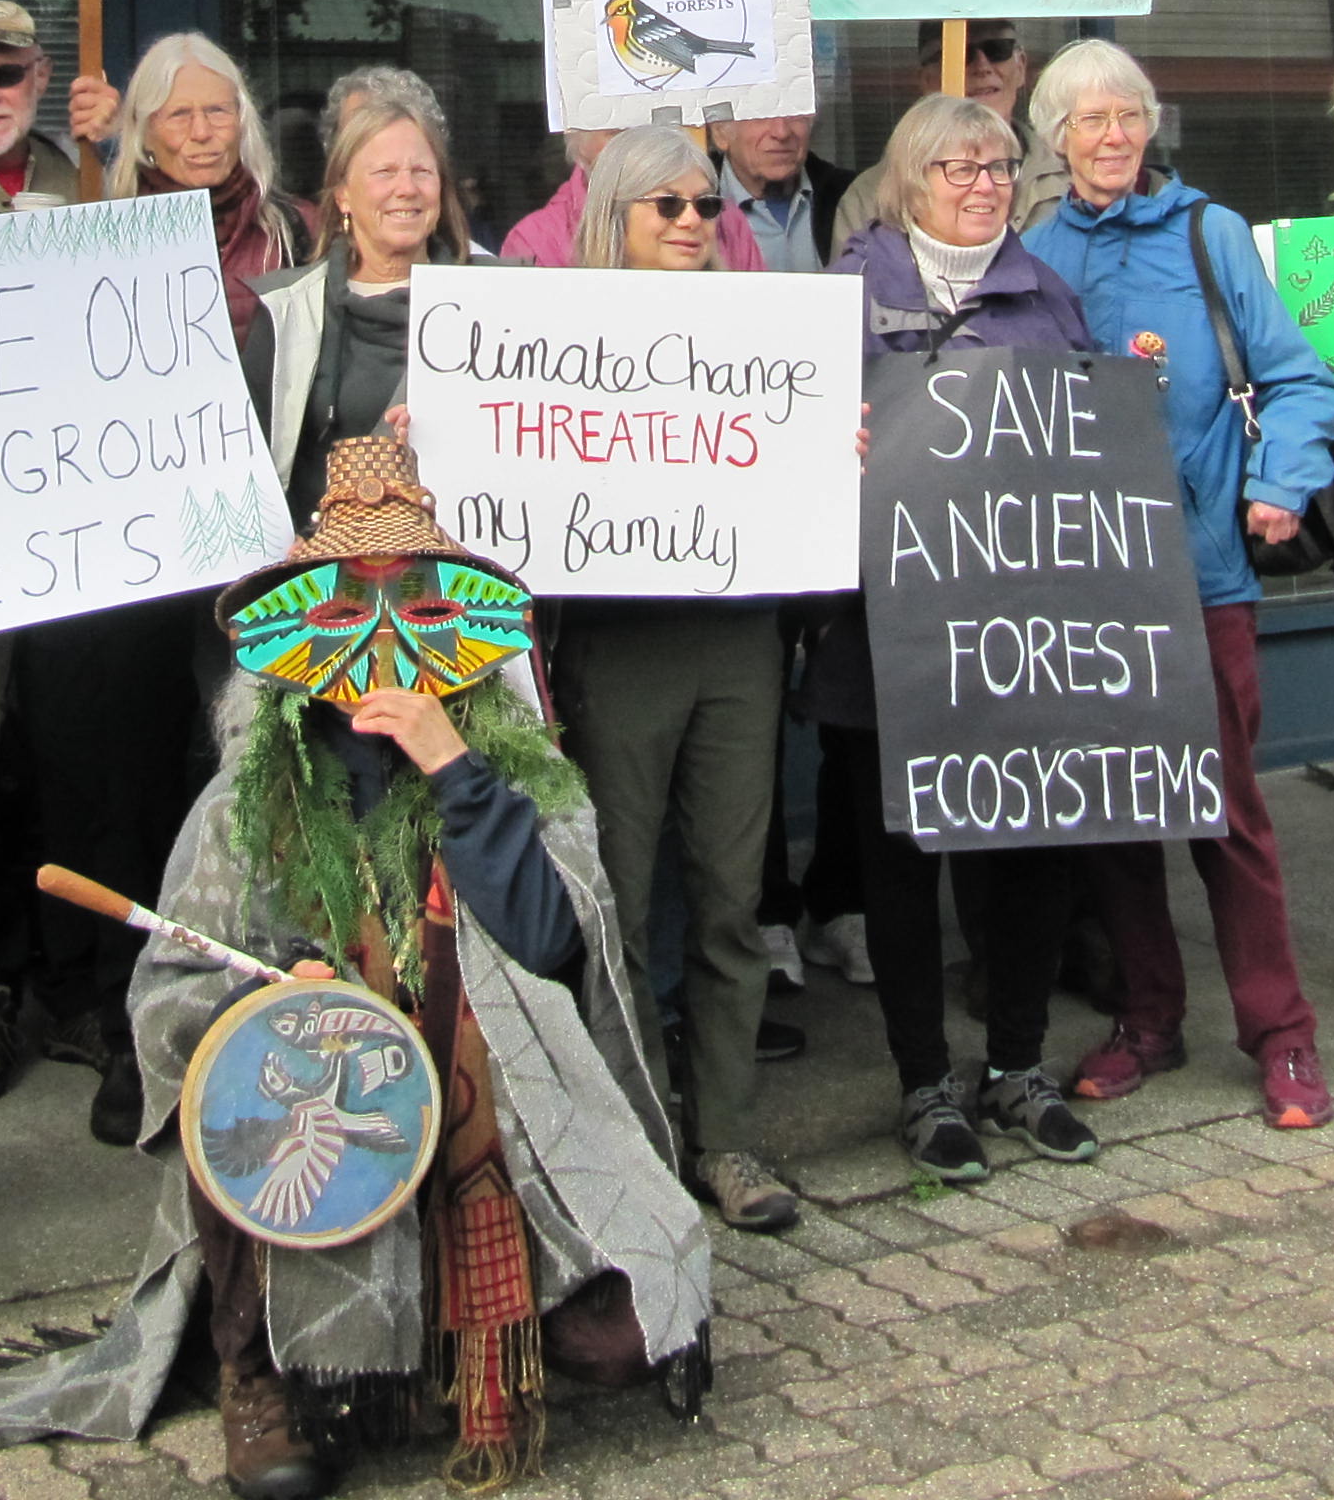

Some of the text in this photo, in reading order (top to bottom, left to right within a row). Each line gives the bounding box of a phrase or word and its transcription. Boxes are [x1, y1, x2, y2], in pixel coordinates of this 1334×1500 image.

[86, 264, 234, 381] OUR
[417, 301, 825, 425] Climate Change
[0, 399, 255, 495] GROWTH
[479, 401, 759, 468] THREATENS
[926, 367, 1102, 460] SAVE
[457, 492, 738, 596] my family
[889, 488, 1174, 587] ANCIENT
[945, 615, 1172, 706] FOREST
[905, 742, 1224, 836] ECOSYSTEMS
